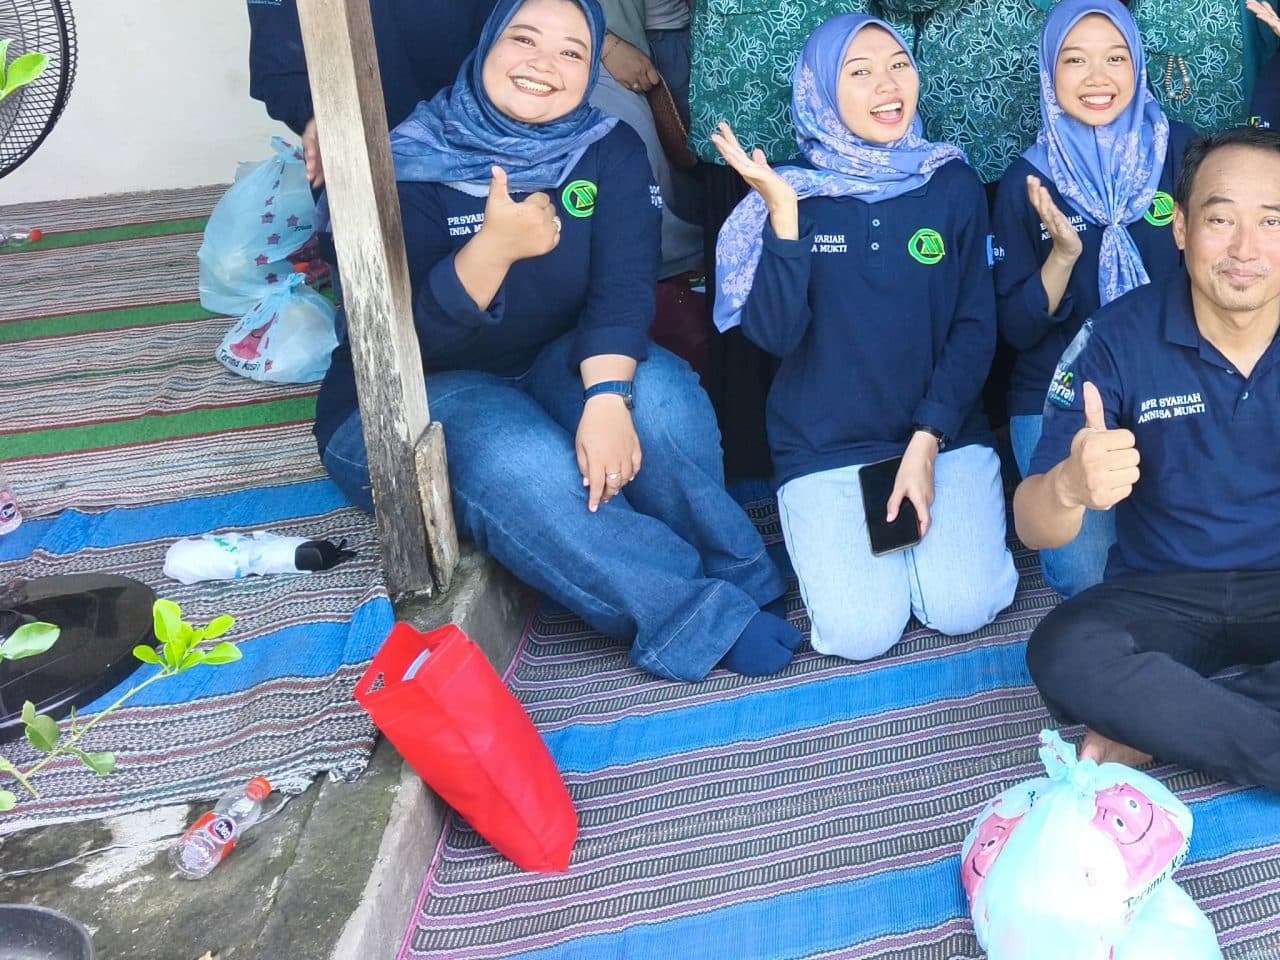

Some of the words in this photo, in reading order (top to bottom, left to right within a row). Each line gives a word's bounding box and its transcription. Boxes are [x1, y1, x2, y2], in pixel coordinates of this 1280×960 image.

[814, 233, 846, 244] YARIAH
[820, 244, 848, 253] MUKTI
[1159, 392, 1202, 408] SYARIAH
[1137, 408, 1172, 424] ANNISA
[1173, 403, 1206, 417] MUKTI
